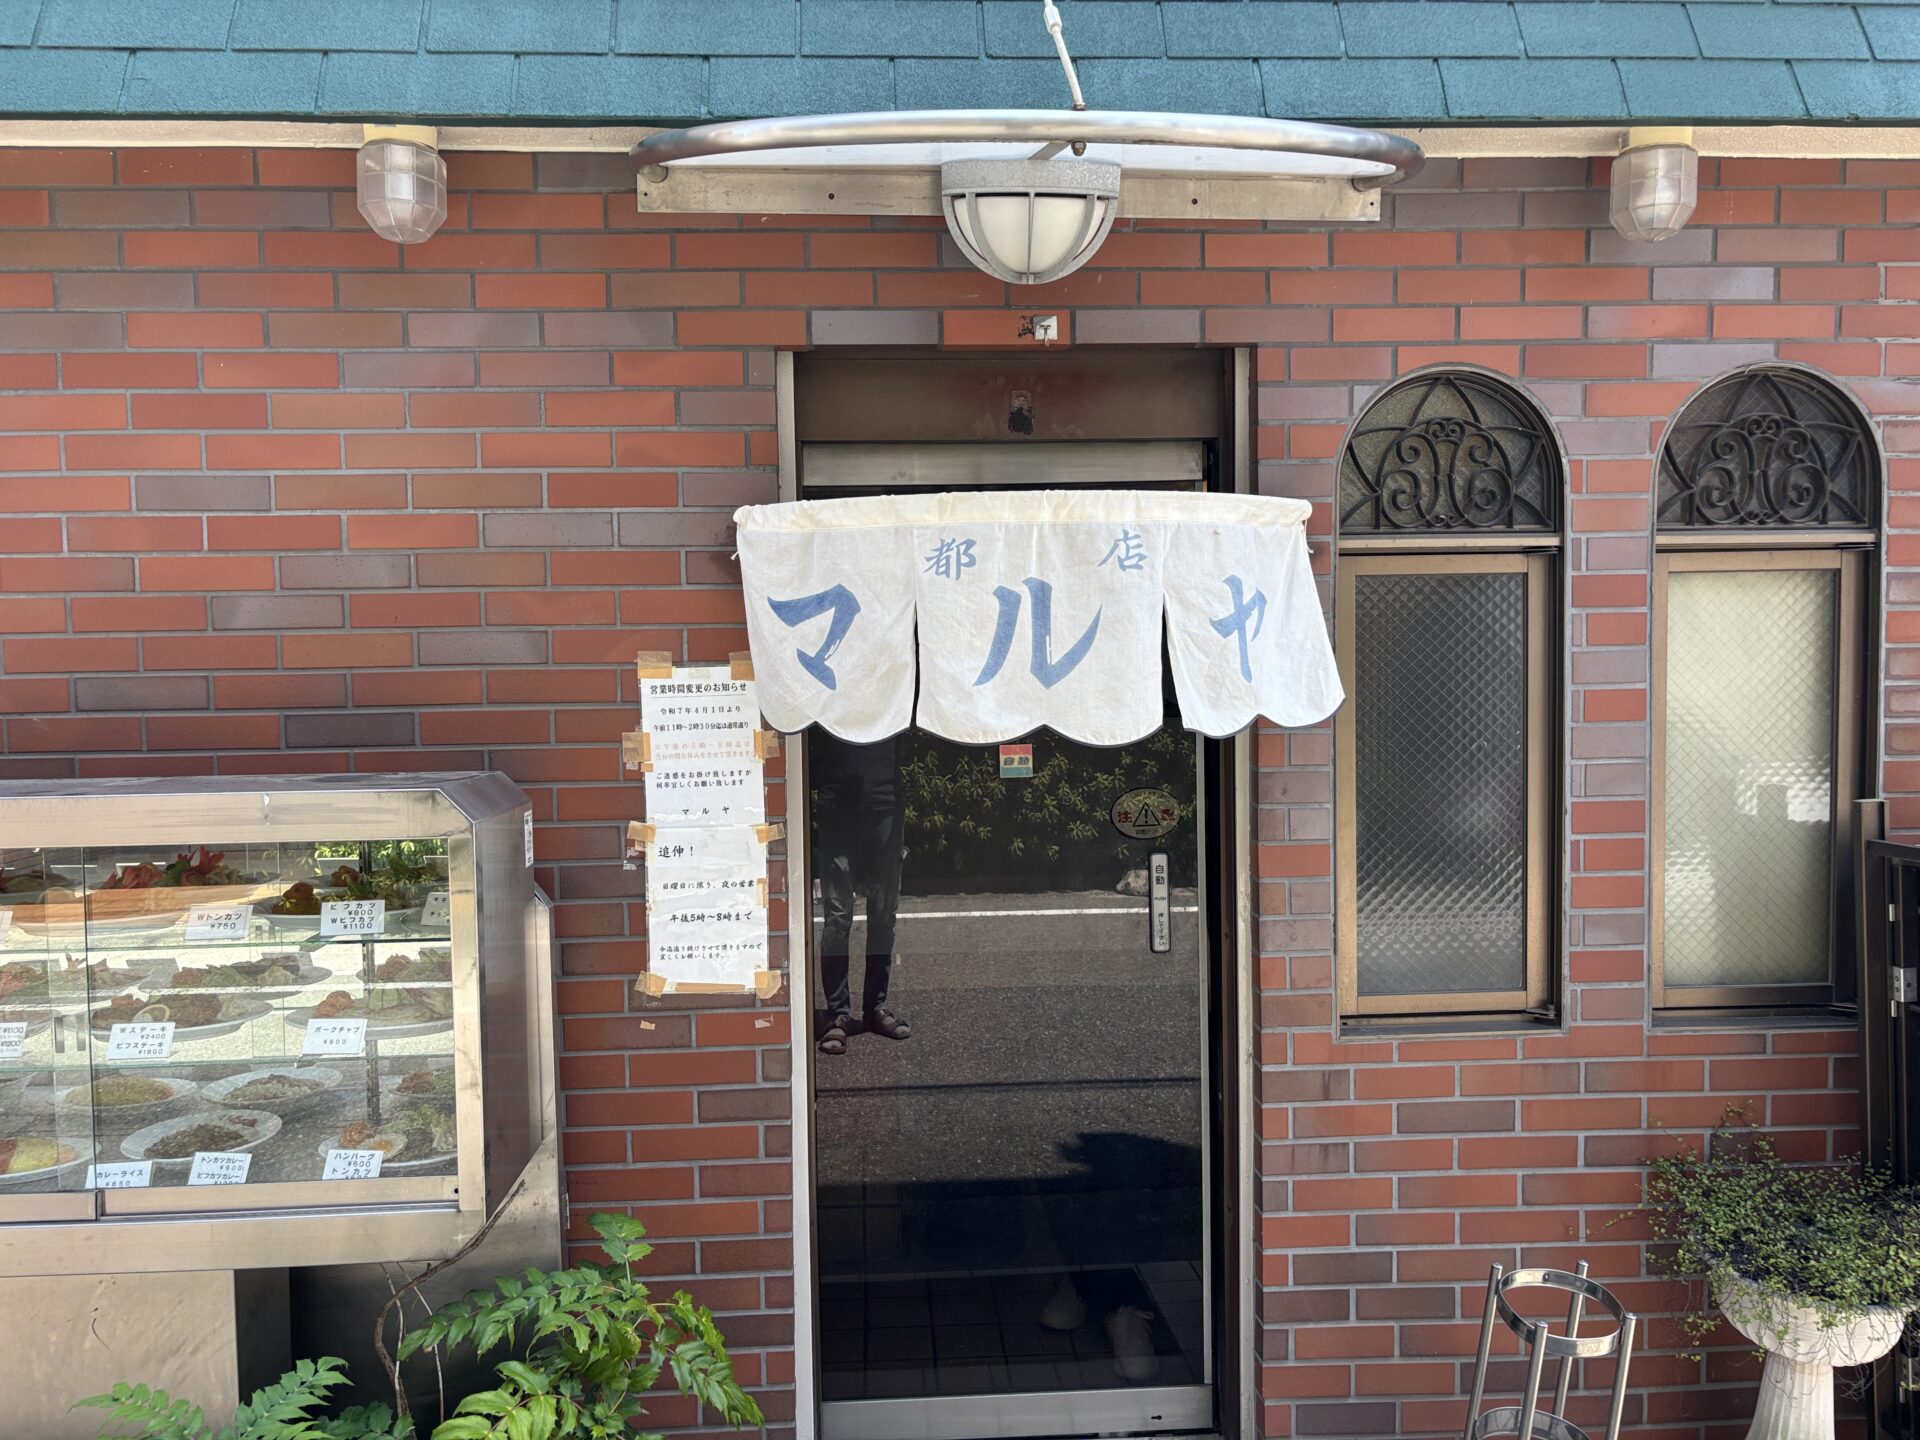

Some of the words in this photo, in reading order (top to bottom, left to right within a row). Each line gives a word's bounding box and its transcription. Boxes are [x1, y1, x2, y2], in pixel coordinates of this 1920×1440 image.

[650, 683, 747, 694] 営業時間変更のお知らせ
[1003, 756, 1030, 766] 自動
[1156, 865, 1165, 885] 自動
[197, 912, 242, 921] Wトンカツ
[343, 922, 373, 930] ¥1100
[119, 1026, 167, 1034] Wステーキ
[200, 1156, 244, 1164] トンカツカレー
[96, 1169, 143, 1178] カレーライス
[332, 1167, 371, 1175] トンカツ
